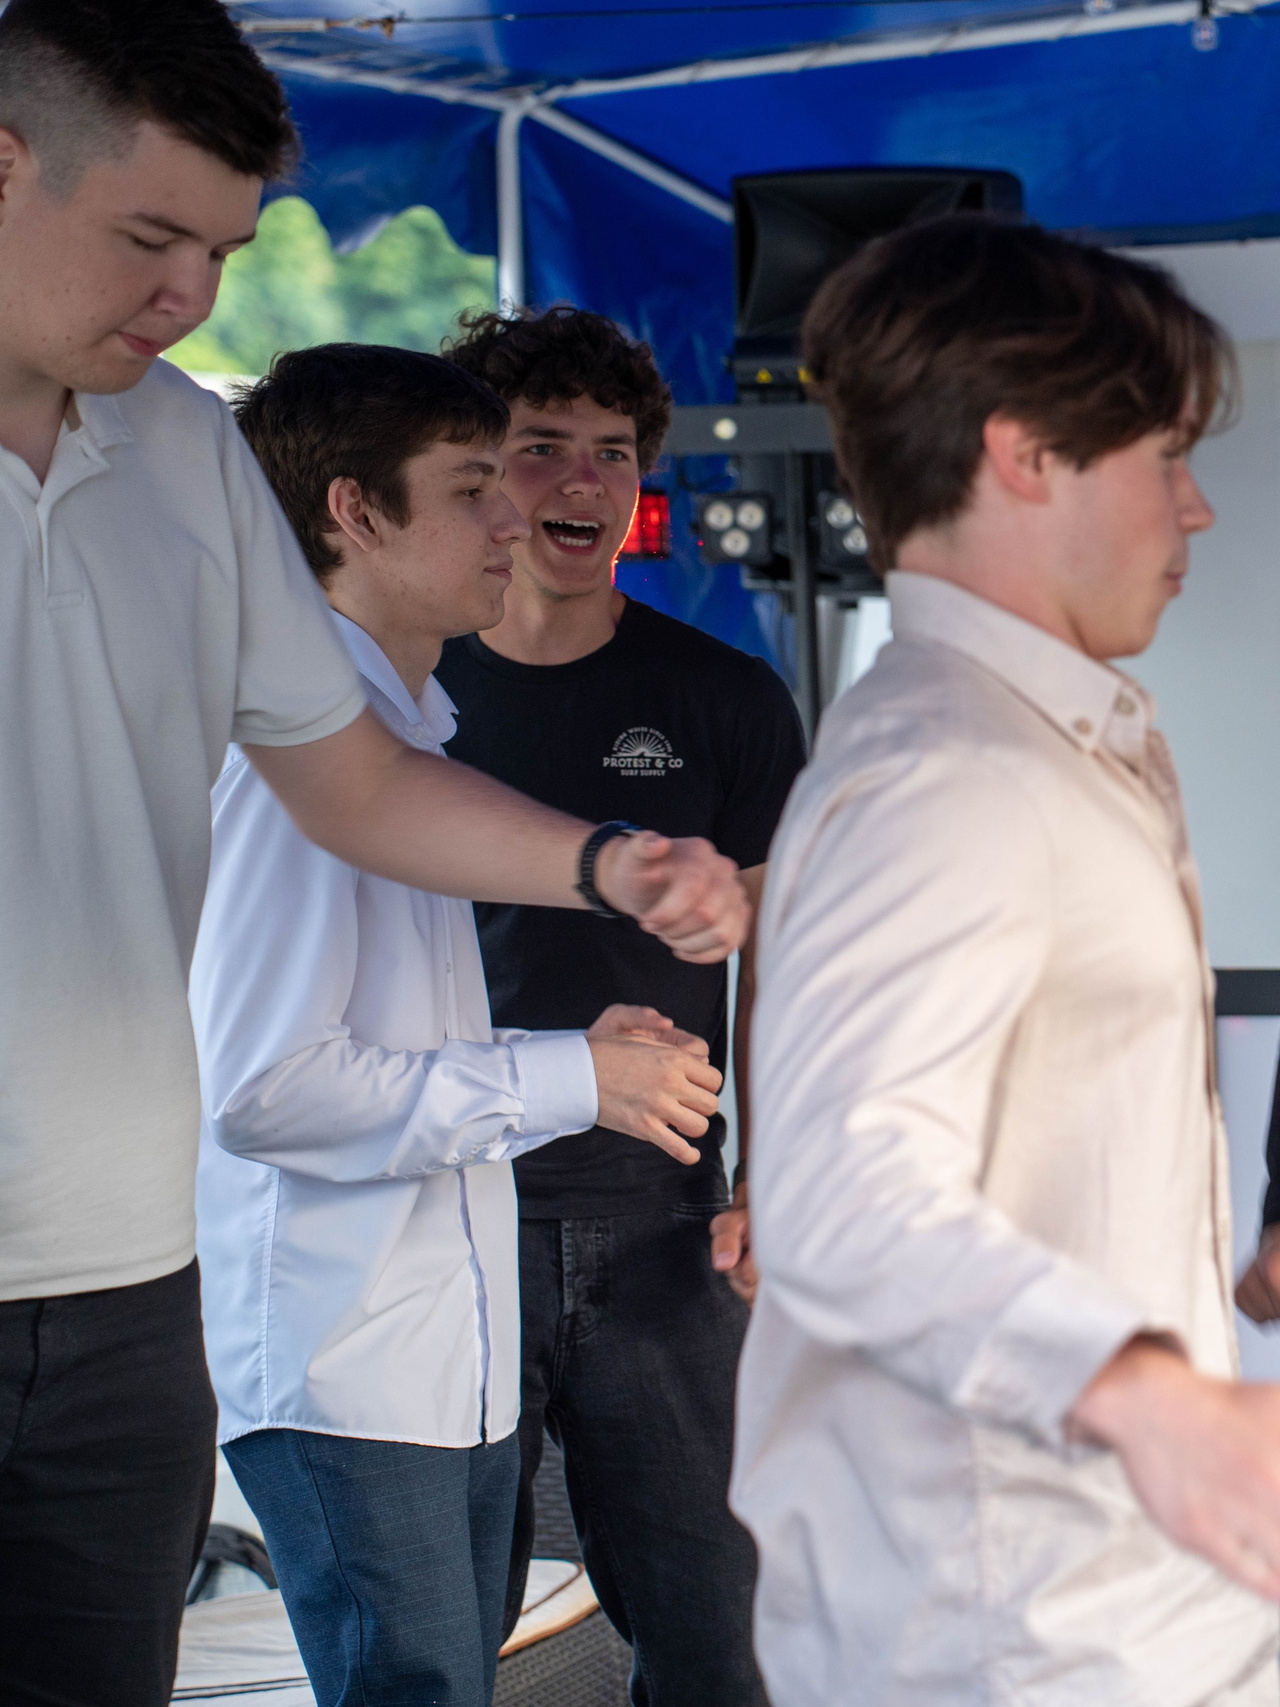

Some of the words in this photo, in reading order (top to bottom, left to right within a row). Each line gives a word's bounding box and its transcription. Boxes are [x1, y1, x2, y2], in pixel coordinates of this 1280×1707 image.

[602, 757, 652, 768] PROTEST
[654, 758, 666, 769] &
[668, 758, 684, 769] CO
[620, 769, 639, 777] SURF
[640, 769, 667, 777] SUPPLY
